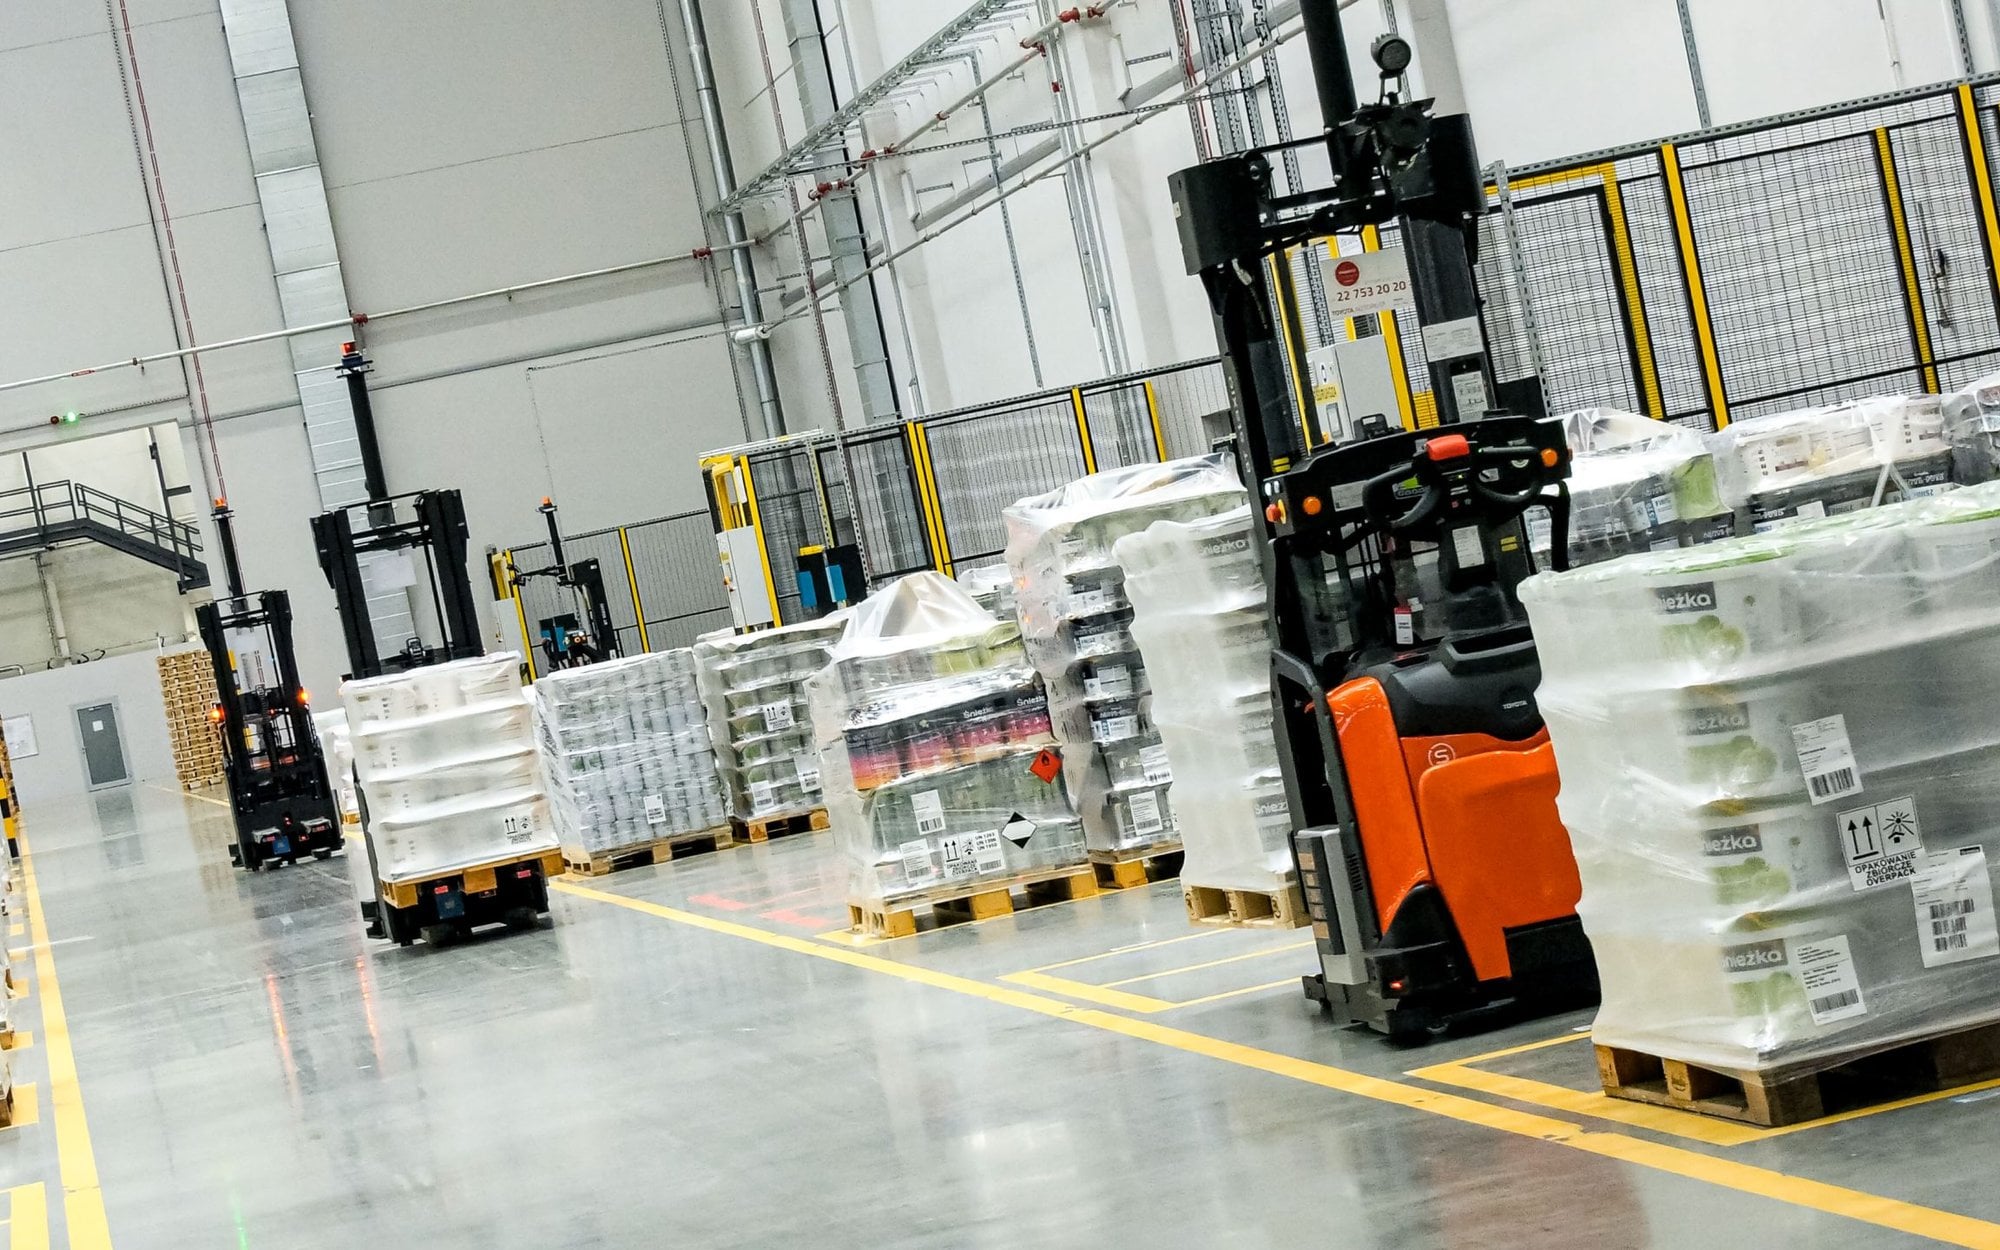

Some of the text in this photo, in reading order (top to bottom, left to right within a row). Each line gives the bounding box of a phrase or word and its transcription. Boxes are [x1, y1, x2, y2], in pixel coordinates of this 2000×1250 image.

[1337, 281, 1407, 302] 22 753 20 20
[1502, 700, 1528, 709] TOYOTA
[1855, 851, 1917, 874] OPAKOWANIE
[1866, 860, 1913, 879] ZBIORCZE
[1866, 867, 1917, 886] OVERPACK
